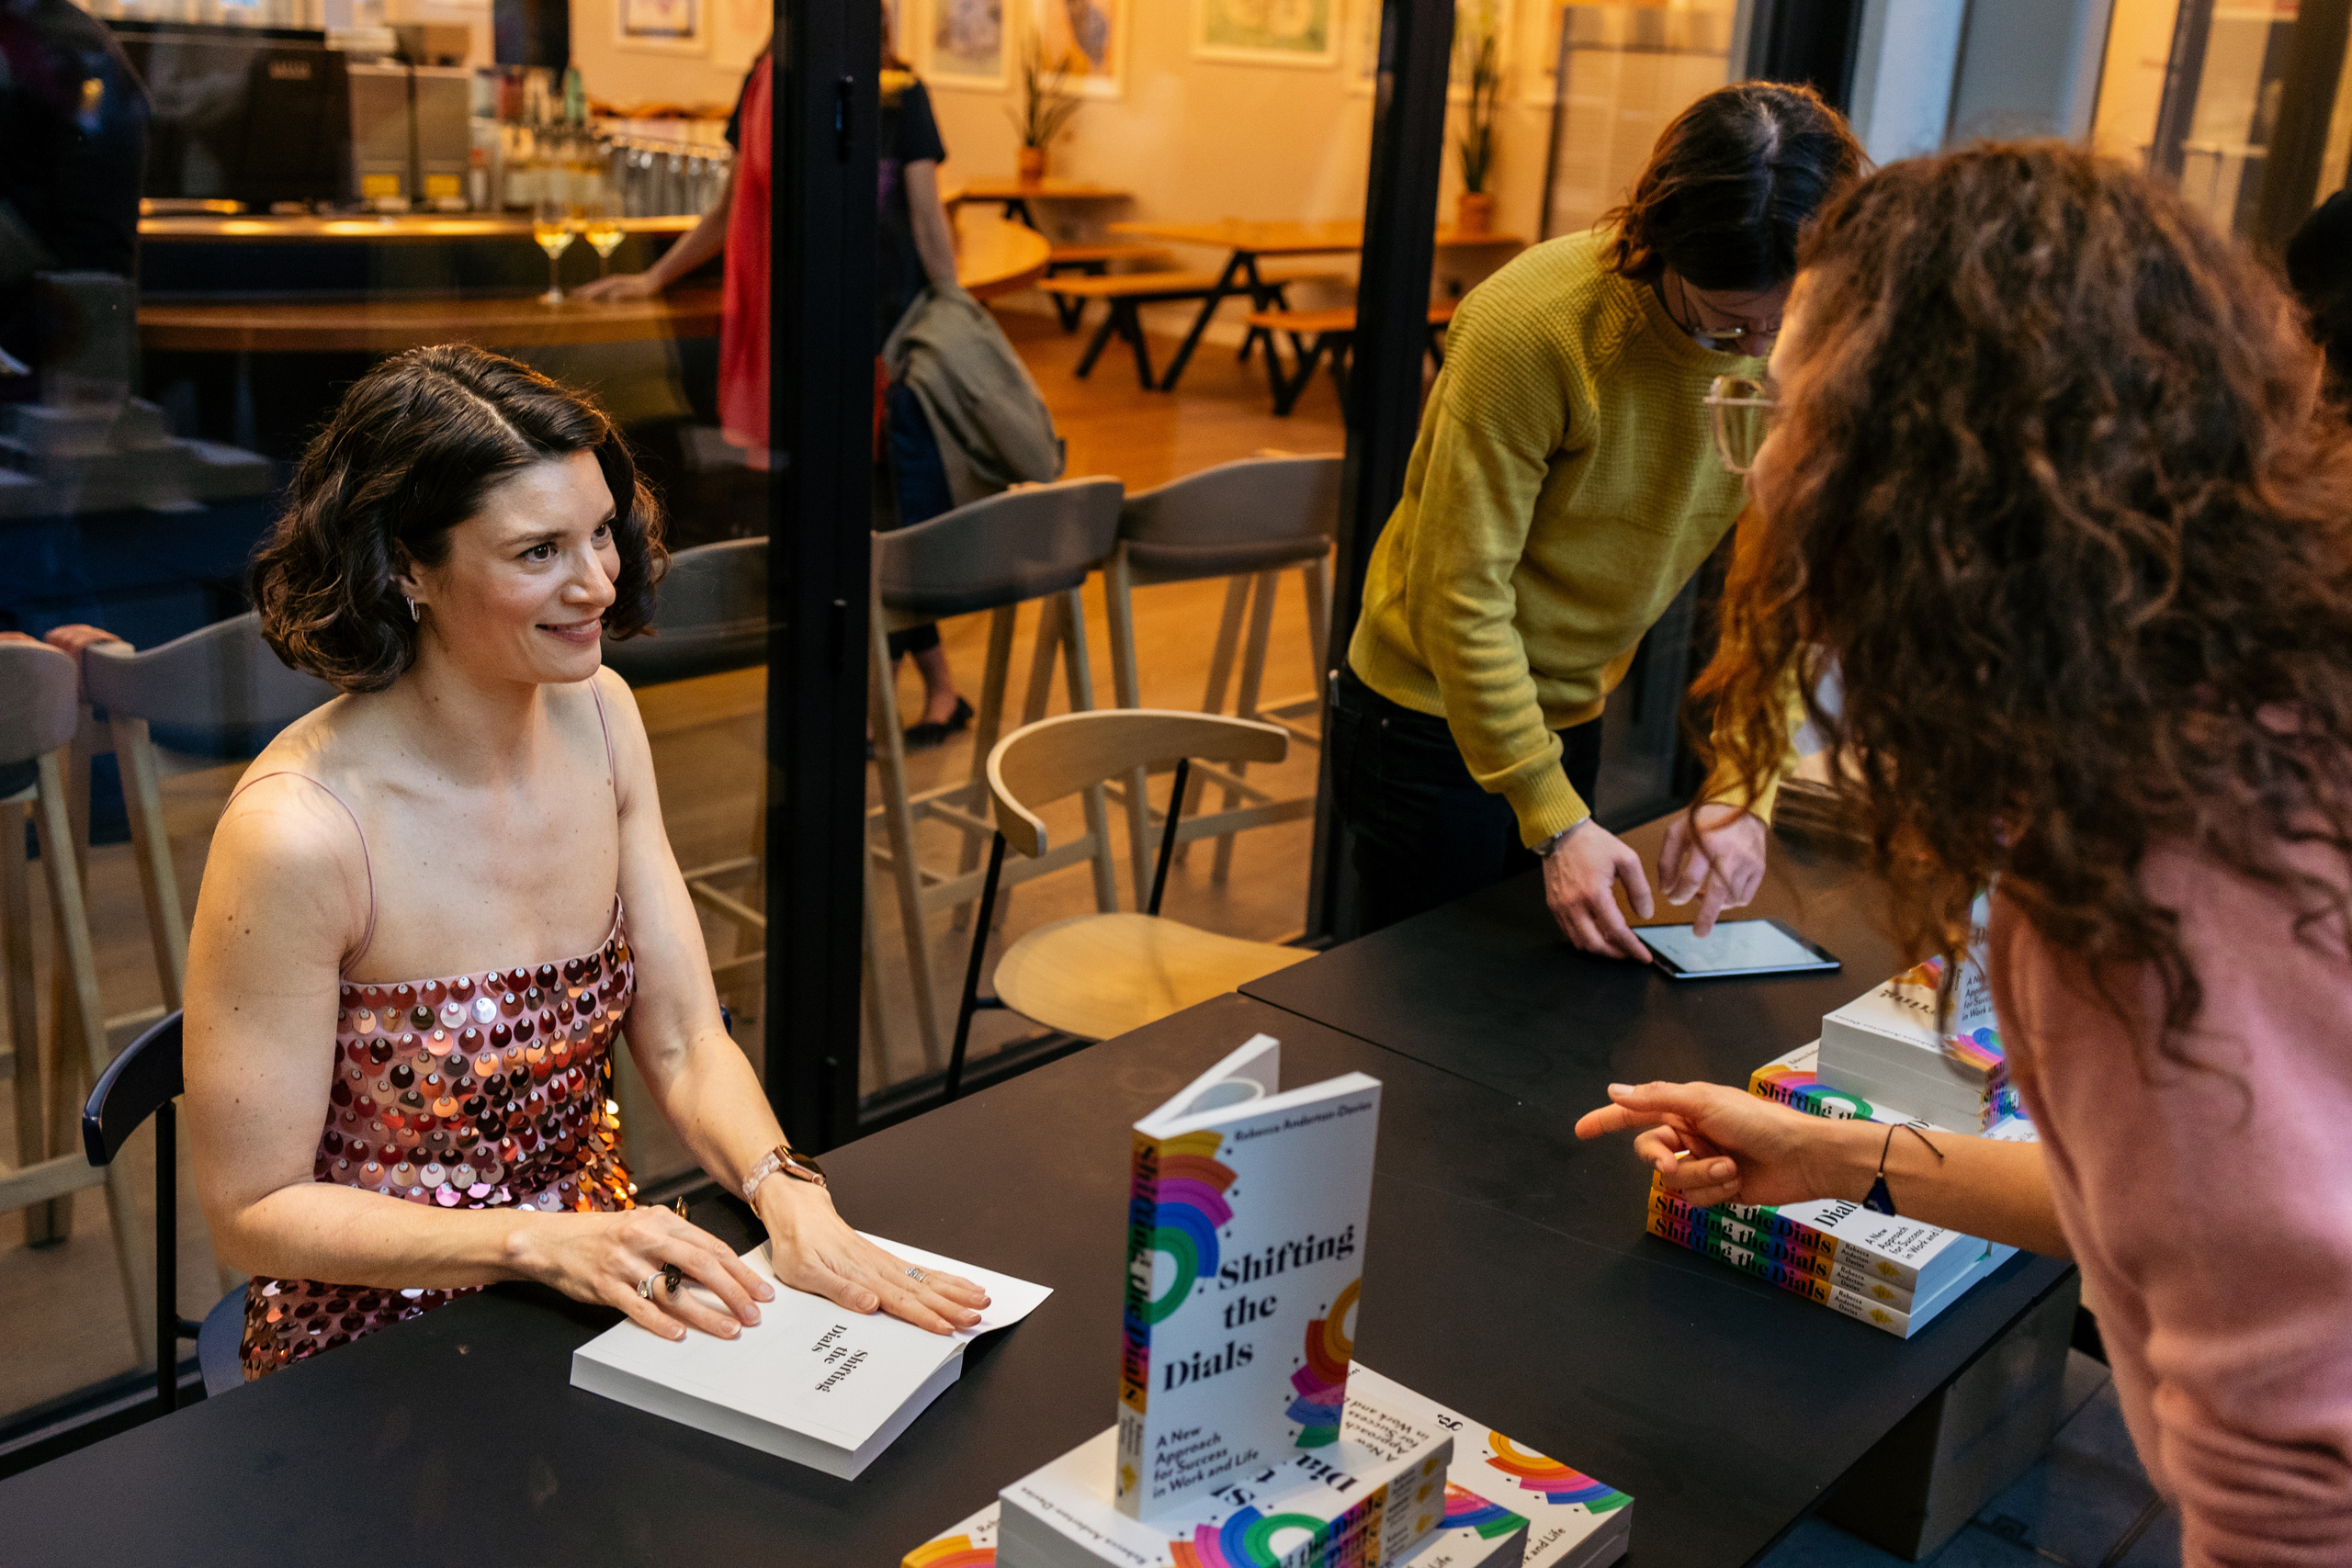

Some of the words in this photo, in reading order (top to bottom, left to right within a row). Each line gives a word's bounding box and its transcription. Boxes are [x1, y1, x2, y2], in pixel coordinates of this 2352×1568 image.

[1757, 1081, 1832, 1120] Shifting
[1235, 1124, 1280, 1142] Rebecca
[1814, 1199, 1858, 1228] Dial
[1656, 1196, 1734, 1241] Shifting
[1739, 1229, 1770, 1253] the
[1773, 1242, 1826, 1277] Dials
[1743, 1205, 1775, 1231] the
[1779, 1219, 1831, 1254] Dials
[1869, 1228, 1888, 1240] New
[1877, 1226, 1909, 1250] Approach
[1897, 1228, 1925, 1247] Success
[1218, 1224, 1355, 1291] Shifting
[1655, 1218, 1732, 1264] Shifting
[1737, 1253, 1769, 1277] the
[1771, 1266, 1825, 1301] Dials
[1845, 1243, 1870, 1258] Rebecca
[1845, 1257, 1865, 1269] Davies
[1840, 1266, 1864, 1281] Rebecca
[1840, 1280, 1860, 1292] Davies
[1838, 1290, 1862, 1304] Rebecca
[1838, 1304, 1859, 1316] Davies
[1224, 1296, 1277, 1330] the
[811, 1325, 848, 1353] Dials
[824, 1347, 848, 1364] the
[1163, 1341, 1254, 1392] Dials
[815, 1349, 868, 1393] Shifting
[1351, 1400, 1378, 1415] and
[1348, 1410, 1399, 1440] Success
[1379, 1413, 1412, 1435] Work
[1155, 1432, 1222, 1465] Approach
[1157, 1435, 1168, 1449] A
[1171, 1427, 1202, 1444] New
[1345, 1421, 1409, 1455] Approach
[1354, 1438, 1385, 1457] New
[1399, 1436, 1419, 1449] for
[1154, 1469, 1173, 1483] for
[1177, 1449, 1228, 1473] Success
[1385, 1452, 1398, 1462] A
[1153, 1487, 1166, 1498] in
[1170, 1472, 1204, 1492] Work
[1208, 1457, 1233, 1477] and
[1235, 1449, 1259, 1467] Life
[1295, 1453, 1359, 1494] Dial
[1530, 1539, 1549, 1556] and
[1543, 1528, 1566, 1542] Life
